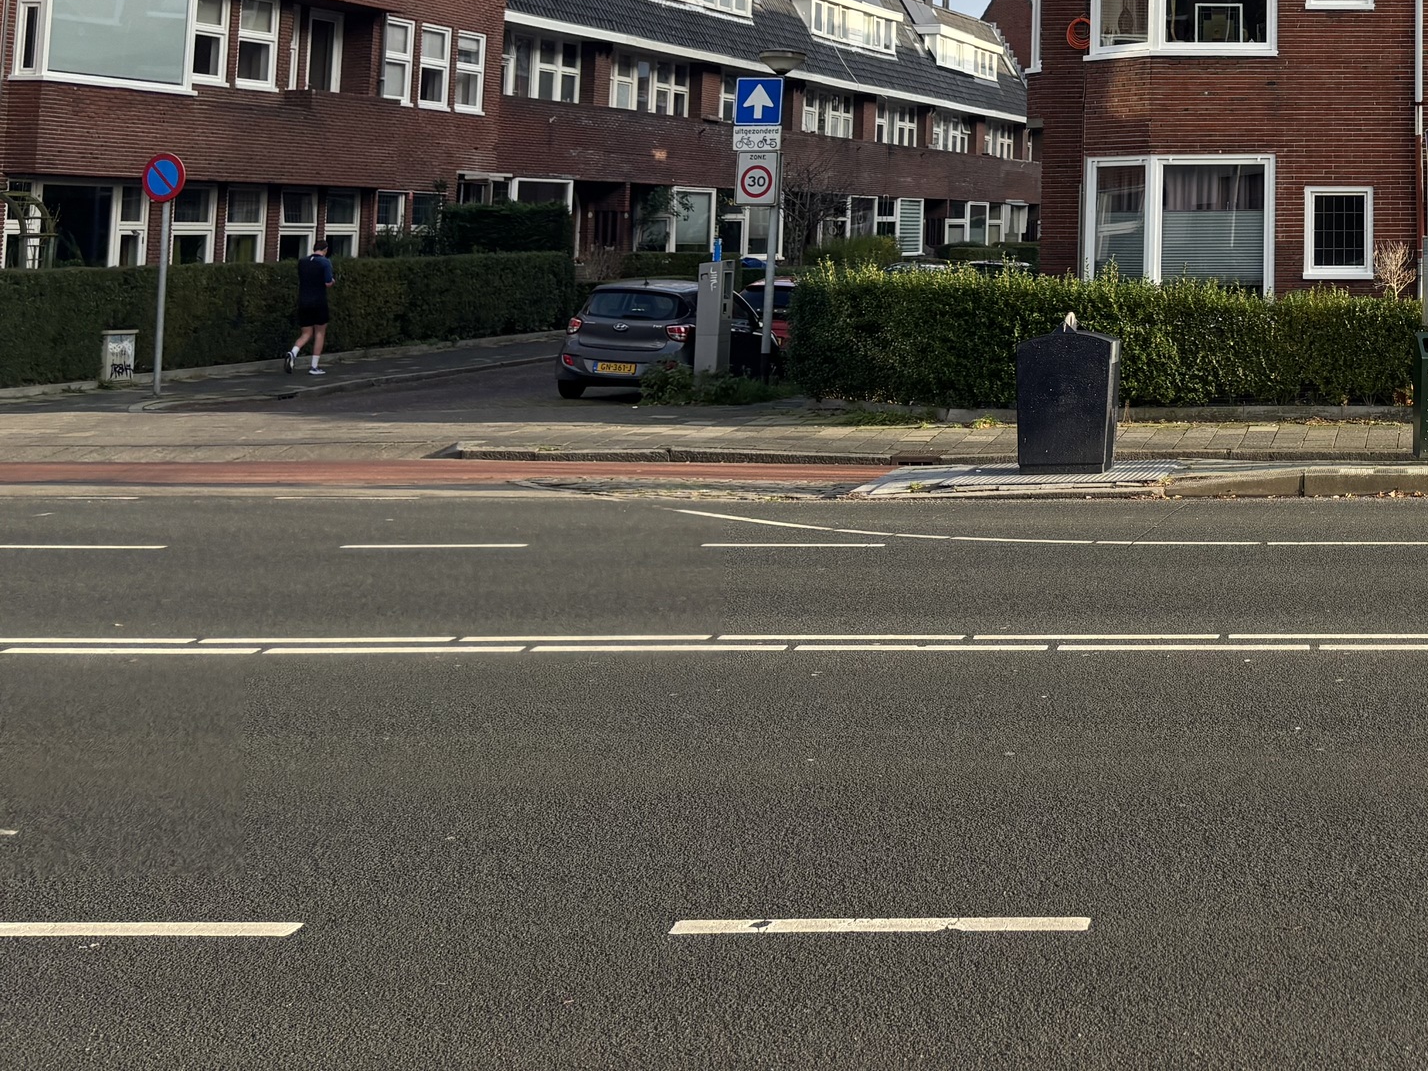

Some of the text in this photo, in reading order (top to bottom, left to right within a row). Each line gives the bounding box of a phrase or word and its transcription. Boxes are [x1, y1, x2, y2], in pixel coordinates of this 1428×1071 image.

[735, 128, 779, 136] uitgezonderd
[747, 175, 766, 187] 30
[600, 363, 632, 371] GN-361-J
